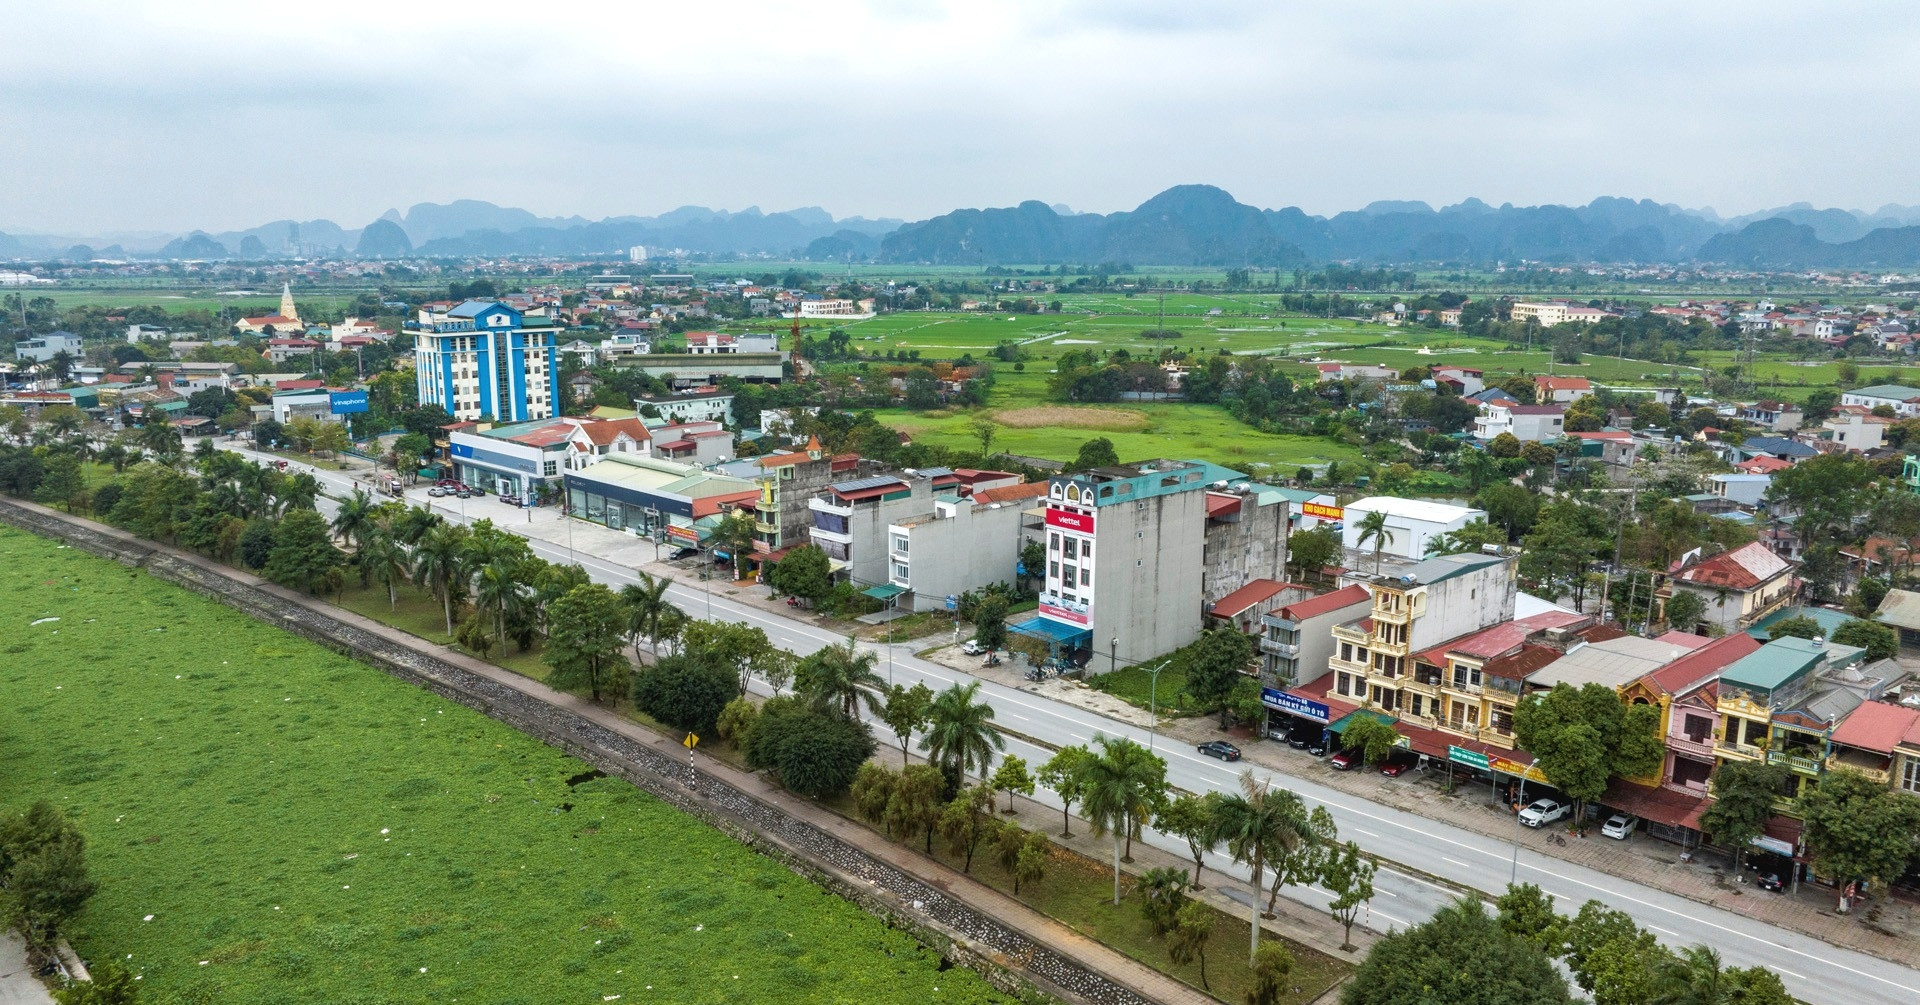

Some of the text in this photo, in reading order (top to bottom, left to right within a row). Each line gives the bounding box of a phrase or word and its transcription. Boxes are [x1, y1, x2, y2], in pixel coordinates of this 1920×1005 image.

[1304, 504, 1313, 512] KHO
[1058, 516, 1080, 526] viettel
[1048, 608, 1068, 618] viettel
[1265, 695, 1277, 703] MUA
[1278, 699, 1290, 707] BÁN
[1311, 707, 1316, 715] Ô
